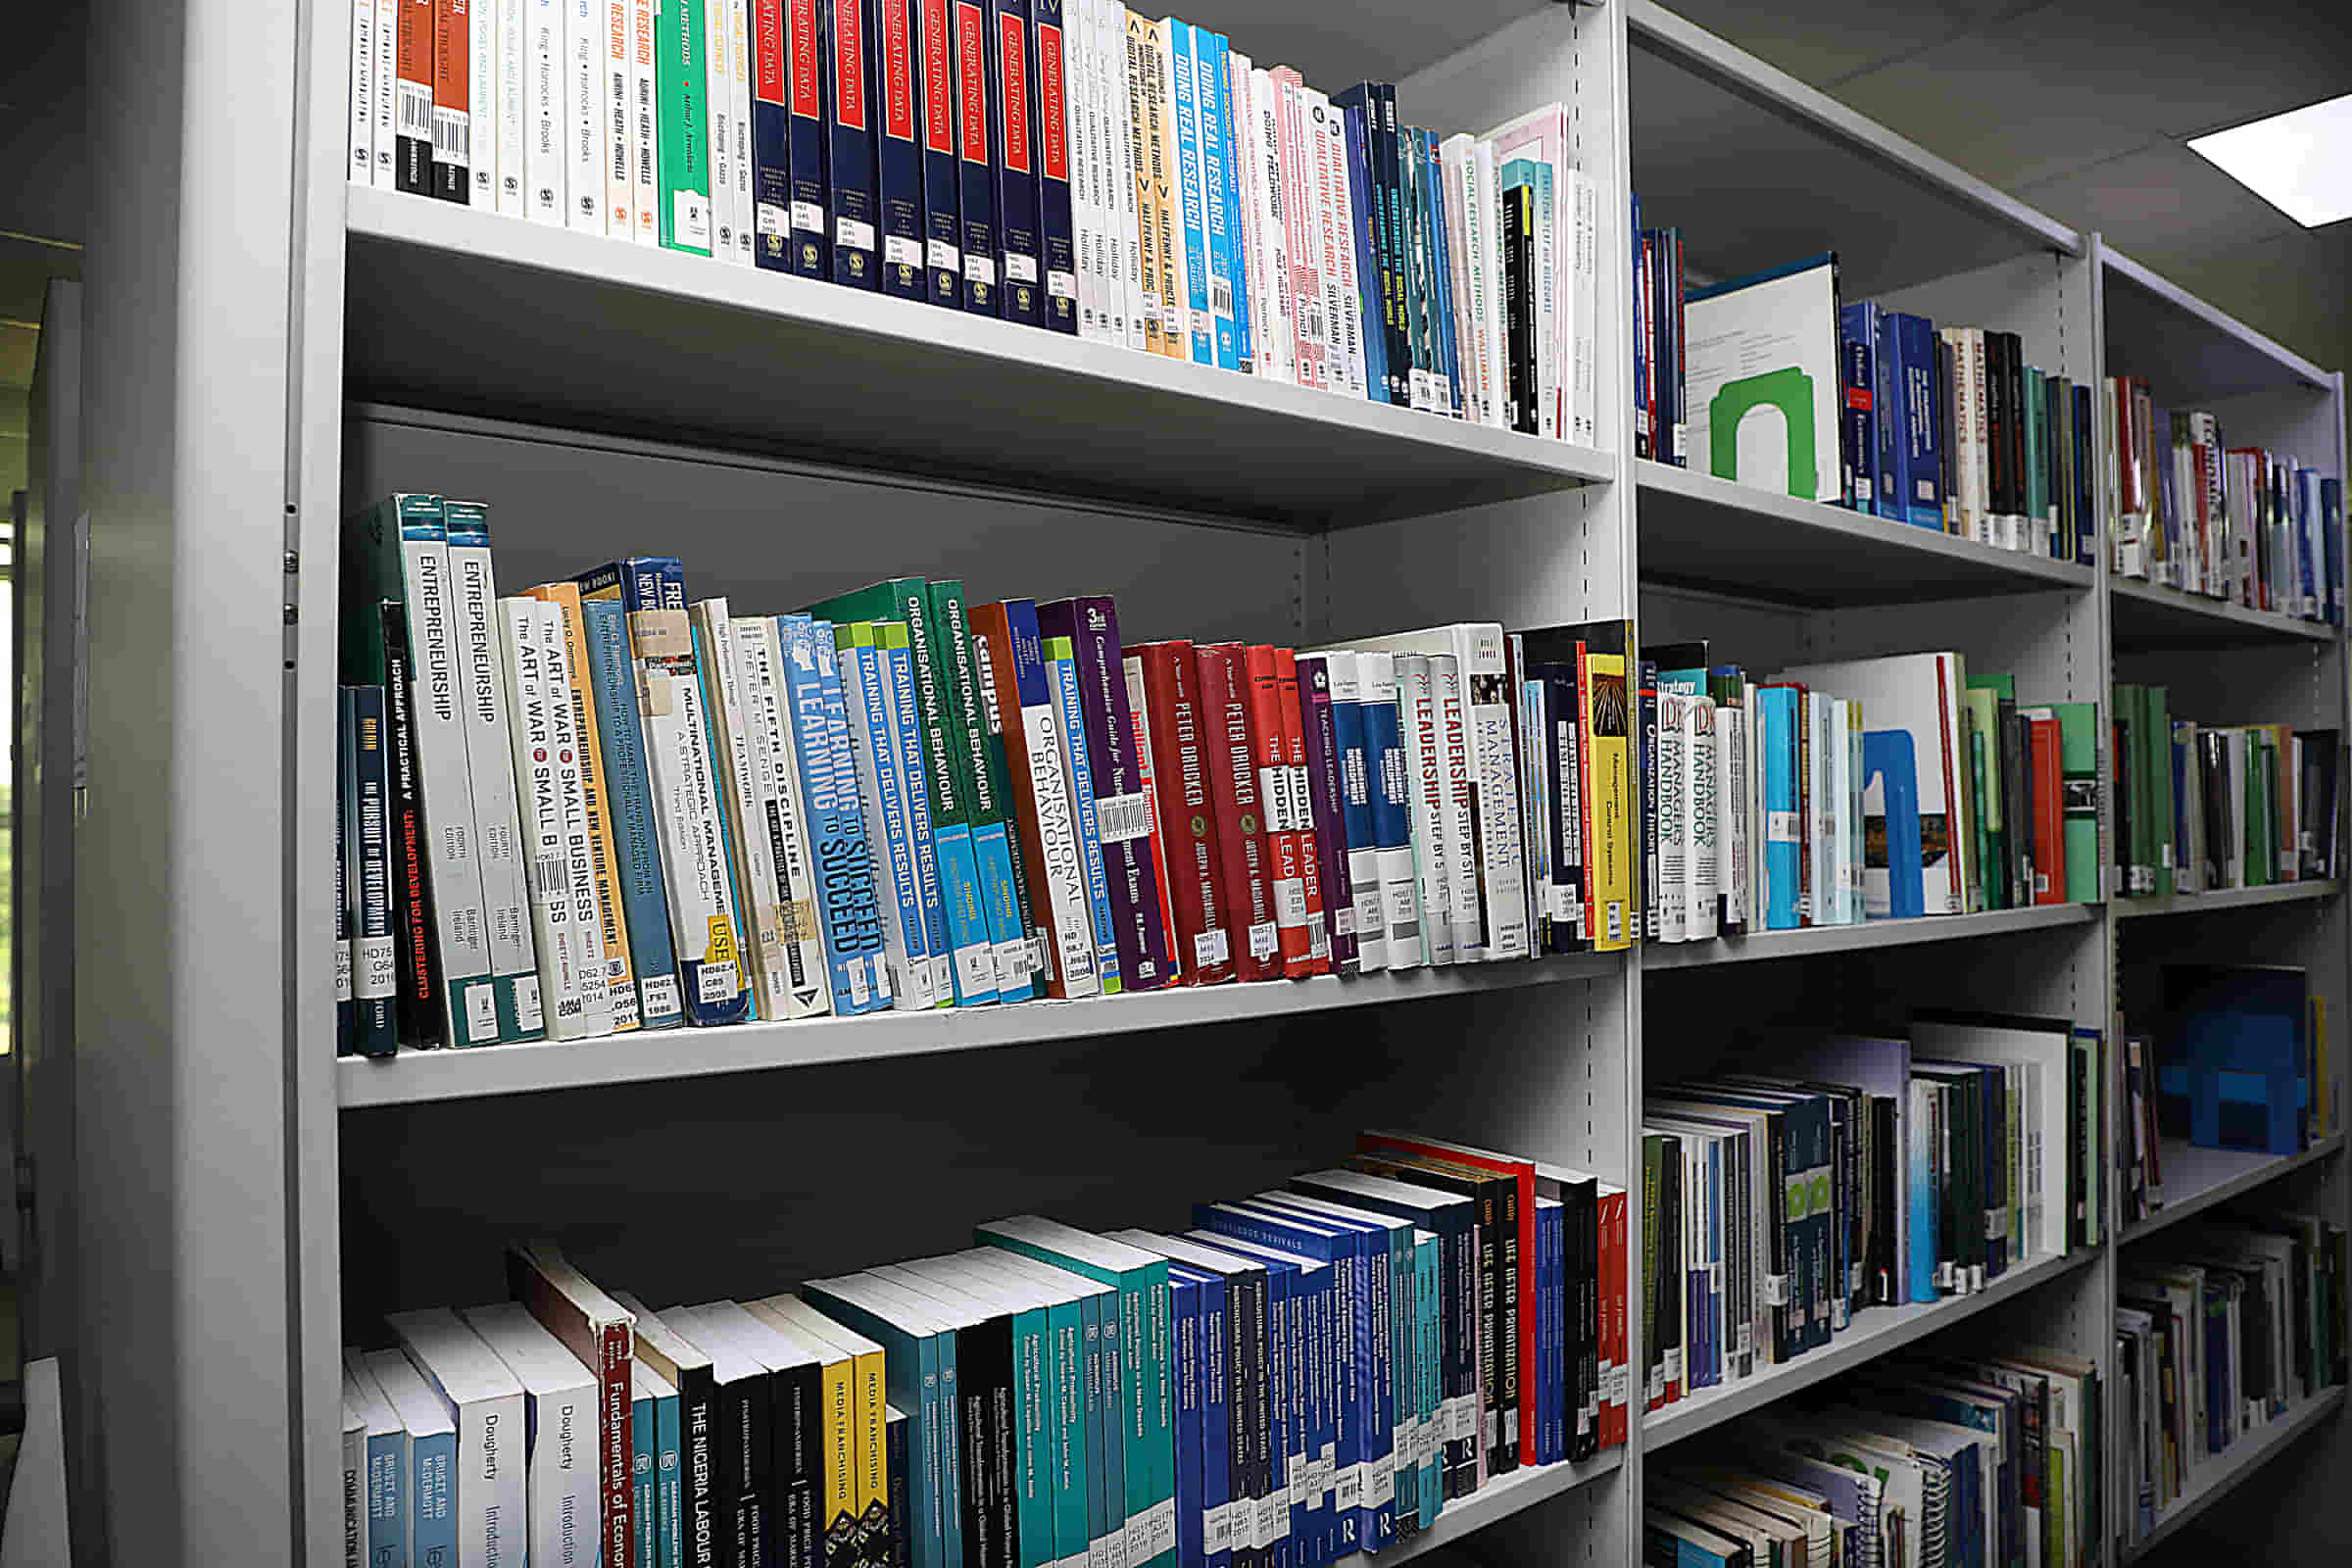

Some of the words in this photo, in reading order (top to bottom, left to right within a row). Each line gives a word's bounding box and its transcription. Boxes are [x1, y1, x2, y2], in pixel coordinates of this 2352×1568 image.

[764, 51, 775, 84] DATA
[930, 8, 943, 102] GENERATING
[964, 21, 977, 112] GENERATING
[1007, 31, 1020, 120] GENERATING
[1047, 41, 1058, 119] GENERATING
[1126, 35, 1137, 72] DIGITAL
[1144, 44, 1154, 80] DIGITAL
[1175, 53, 1192, 101] DOING
[800, 67, 810, 100] DATA
[846, 77, 857, 110] DATA
[894, 87, 904, 122] DATA
[1128, 74, 1141, 125] RESEARCH
[1148, 82, 1159, 133] RESEARCH
[1199, 61, 1214, 109] DOING
[933, 103, 944, 135] DATA
[968, 114, 979, 147] DATA
[1012, 123, 1022, 155] DATA
[1050, 124, 1059, 164] DATA
[1179, 105, 1195, 146] REAL
[1203, 113, 1218, 153] REAL
[1132, 126, 1144, 172] METHODS
[1152, 135, 1162, 179] METHODS
[1315, 129, 1328, 208] QUALITATIVE
[1182, 148, 1200, 230] RESEARCH
[1205, 155, 1225, 236] RESEARCH
[1331, 142, 1344, 220] QUALITATIVE
[1080, 228, 1090, 271] Holliday
[1094, 234, 1104, 276] Holliday
[1109, 238, 1120, 280] Holliday
[1142, 203, 1154, 257] HALFPENNY
[1159, 209, 1172, 263] HALFPENNY
[1320, 211, 1336, 277] RESEARCH
[1336, 221, 1352, 288] RESEARCH
[1128, 241, 1139, 282] Holliday
[1297, 297, 1307, 337] Punch
[1326, 282, 1341, 345] SILVERMAN
[419, 555, 453, 721] ENTREPRENEURSHIP
[465, 561, 496, 723] ENTREPRENEURSHIP
[517, 616, 530, 641] The
[543, 620, 556, 644] The
[520, 645, 540, 680] ART
[523, 684, 537, 697] of
[546, 649, 565, 683] ART
[757, 649, 773, 687] THE
[860, 651, 883, 722] TRAINING
[892, 652, 914, 726] TRAINING
[391, 660, 407, 736] APPROACH
[525, 702, 547, 743] WAR
[550, 686, 564, 700] of
[744, 649, 760, 707] PETER
[754, 735, 774, 794] SENGE
[906, 595, 938, 726] ORGANISATIONAL
[926, 727, 955, 811] BEHAVIOUR
[947, 599, 976, 726] ORGANISATIONAL
[966, 727, 993, 811] BEHAVIOUR
[1059, 664, 1076, 731] TRAINING
[552, 704, 572, 744] WAR
[570, 688, 595, 783] ENTREPRENEURSHIP
[761, 696, 782, 754] FIFTH
[794, 683, 840, 810] LEARNING
[823, 688, 863, 812] LEARNING
[873, 726, 888, 764] THAT
[903, 729, 921, 767] THAT
[1070, 733, 1084, 768] THAT
[1129, 710, 1148, 772] brilliant
[1174, 703, 1195, 743] PETER
[1224, 703, 1246, 743] PETER
[1269, 734, 1280, 761] THE
[1290, 737, 1302, 762] THE
[397, 739, 412, 788] PRACTICAL
[1180, 746, 1203, 807] DRUCKER
[1231, 746, 1254, 805] DRUCKER
[1416, 698, 1441, 809] LEADERSHIP
[1444, 698, 1468, 808] LEADERSHIP
[529, 767, 552, 833] SMALL
[557, 768, 580, 829] SMALL
[587, 810, 602, 832] NEW
[683, 687, 712, 817] MULTINATIONAL
[703, 819, 727, 914] MANAGEME
[774, 762, 801, 879] DISCIPLINE
[879, 767, 901, 841] DELIVERS
[909, 770, 930, 842] DELIVERS
[1030, 751, 1062, 878] BEHAVIOUR
[1040, 716, 1082, 906] ORGANISATIONAL
[1075, 770, 1093, 837] DELIVERS
[1272, 765, 1291, 830] HIDDEN
[1294, 766, 1309, 830] HIDDEN
[1486, 720, 1510, 870] MANAGEMENT
[1660, 739, 1674, 844] HANDBOOK
[1693, 744, 1706, 847] HANDBOOK
[823, 815, 841, 834] TO
[841, 815, 858, 835] TO
[1429, 811, 1441, 840] STEP
[1433, 844, 1443, 858] BY
[1457, 809, 1470, 841] STEP
[1460, 843, 1472, 859] BY
[565, 835, 593, 923] BUSINESS
[589, 834, 606, 876] VENTURE
[892, 843, 914, 908] RESULTS
[919, 844, 939, 908] RESULTS
[1086, 839, 1104, 900] RESULTS
[1278, 834, 1295, 877] LEAD
[1300, 832, 1317, 897] LEADER
[597, 878, 617, 945] MANAGEMENT
[820, 838, 860, 955] SUCCEED
[844, 841, 881, 953] SUCCEED
[1483, 1243, 1493, 1267] LIFE
[1504, 1239, 1517, 1262] LIFE
[1483, 1272, 1494, 1309] AFTER
[1504, 1268, 1516, 1305] AFTER
[1483, 1313, 1494, 1404] PRIVATIZATION
[1504, 1308, 1517, 1399] PRIVATIZATION
[483, 1414, 499, 1480] Dougherty
[560, 1404, 574, 1470] Dougherty
[610, 1381, 627, 1490] Fundamentals
[690, 1402, 708, 1435] THE
[692, 1437, 709, 1497] NIGERIA
[837, 1421, 848, 1500] FRANCHISING
[869, 1412, 878, 1490] FRANCHISING
[563, 1494, 577, 1565] Introduction
[612, 1494, 628, 1509] of
[694, 1500, 710, 1563] LABOUR
